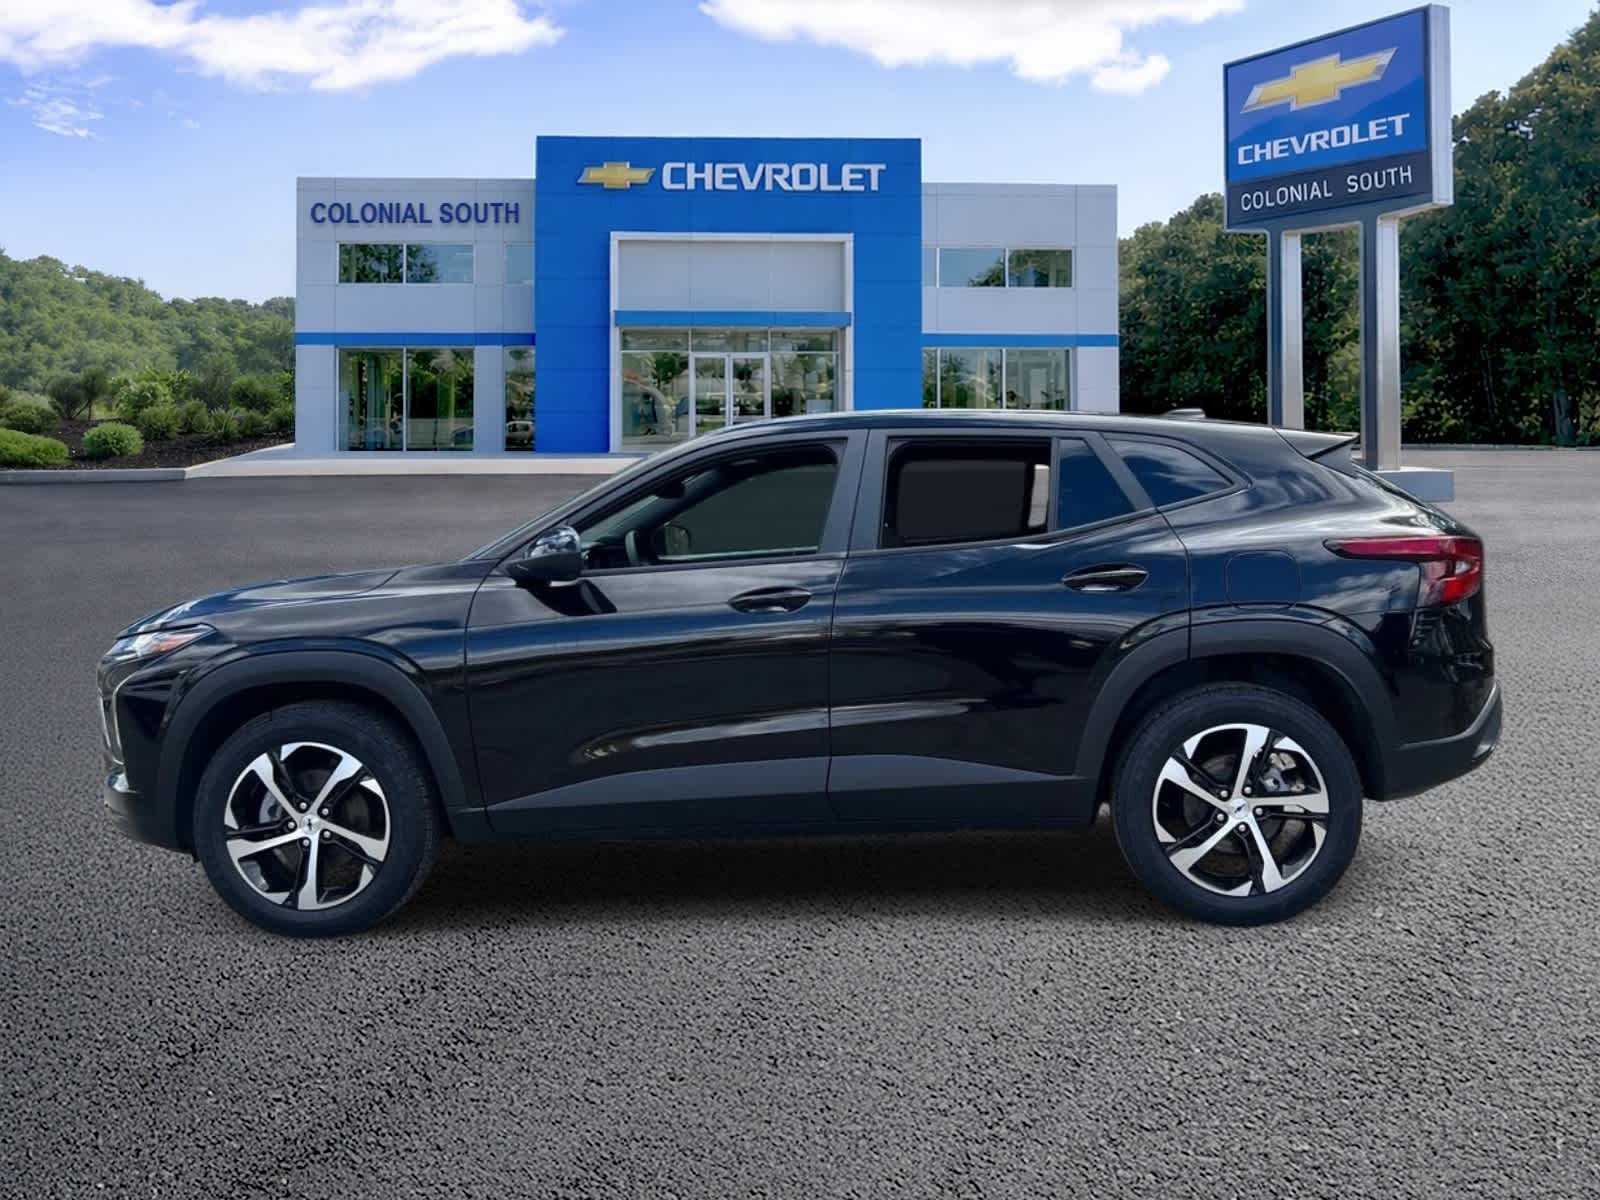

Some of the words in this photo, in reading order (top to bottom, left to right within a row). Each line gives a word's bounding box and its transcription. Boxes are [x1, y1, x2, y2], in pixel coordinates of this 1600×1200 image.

[1238, 113, 1410, 165] CHEVROLET
[662, 162, 886, 192] CHEVROLET
[1241, 180, 1332, 211] COLONIAL
[1347, 165, 1412, 194] SOUTH
[311, 202, 433, 224] COLONIAL
[439, 203, 520, 225] SOUTH
